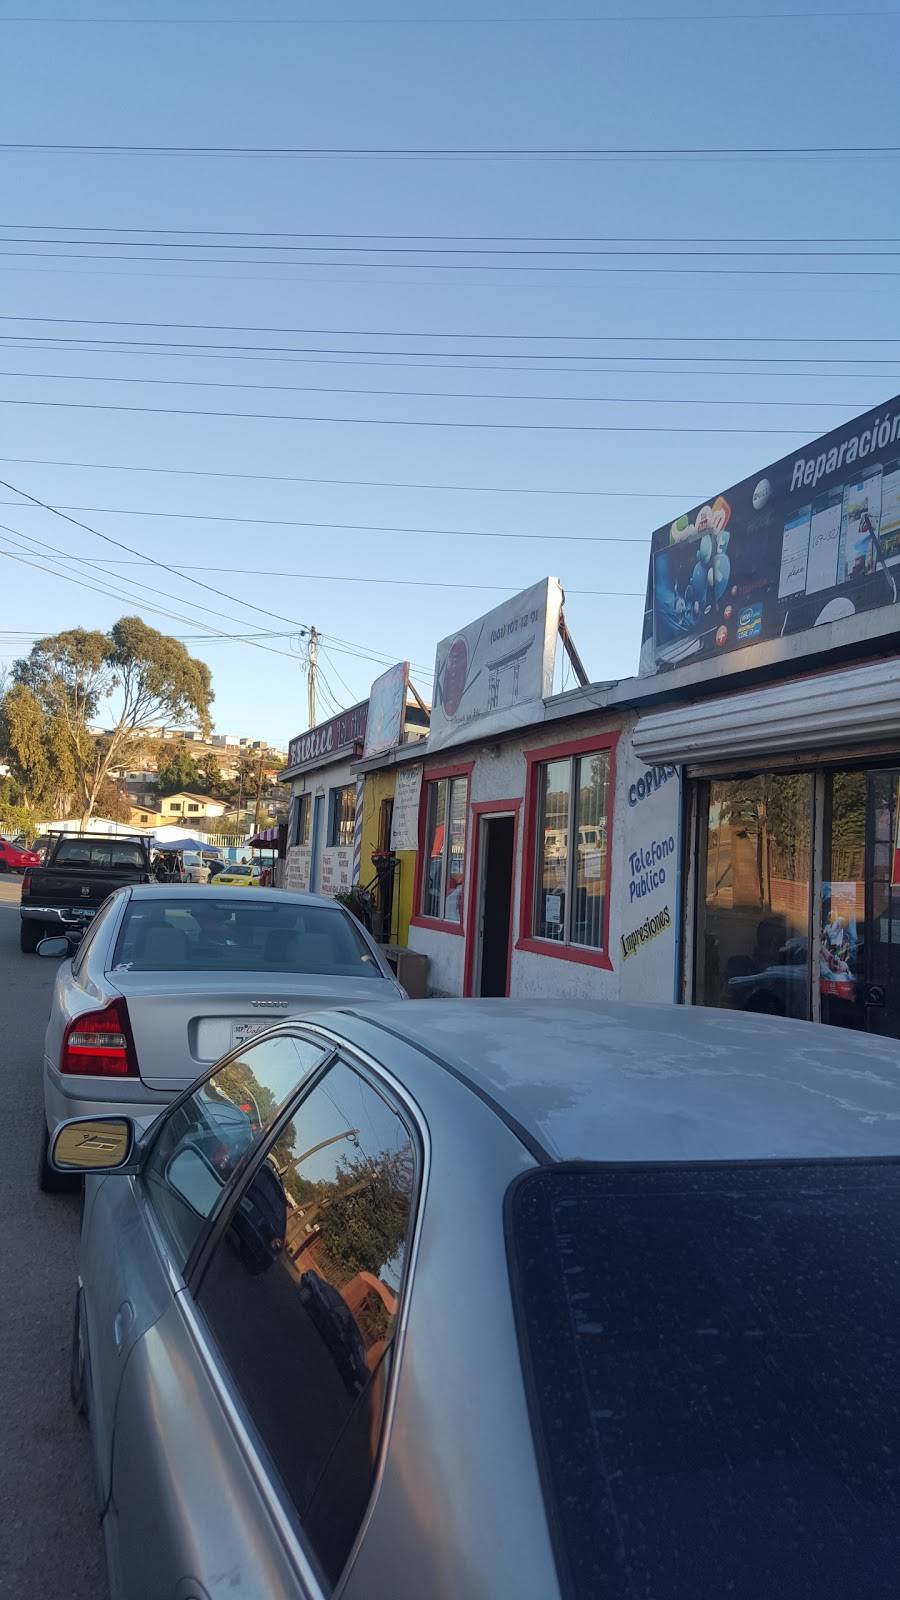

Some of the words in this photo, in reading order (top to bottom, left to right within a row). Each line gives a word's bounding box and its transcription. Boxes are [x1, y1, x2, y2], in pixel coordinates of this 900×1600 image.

[789, 413, 900, 492] Reparación
[628, 766, 675, 807] COPIAS
[629, 836, 675, 877] Telefono
[621, 905, 671, 958] Impresiones
